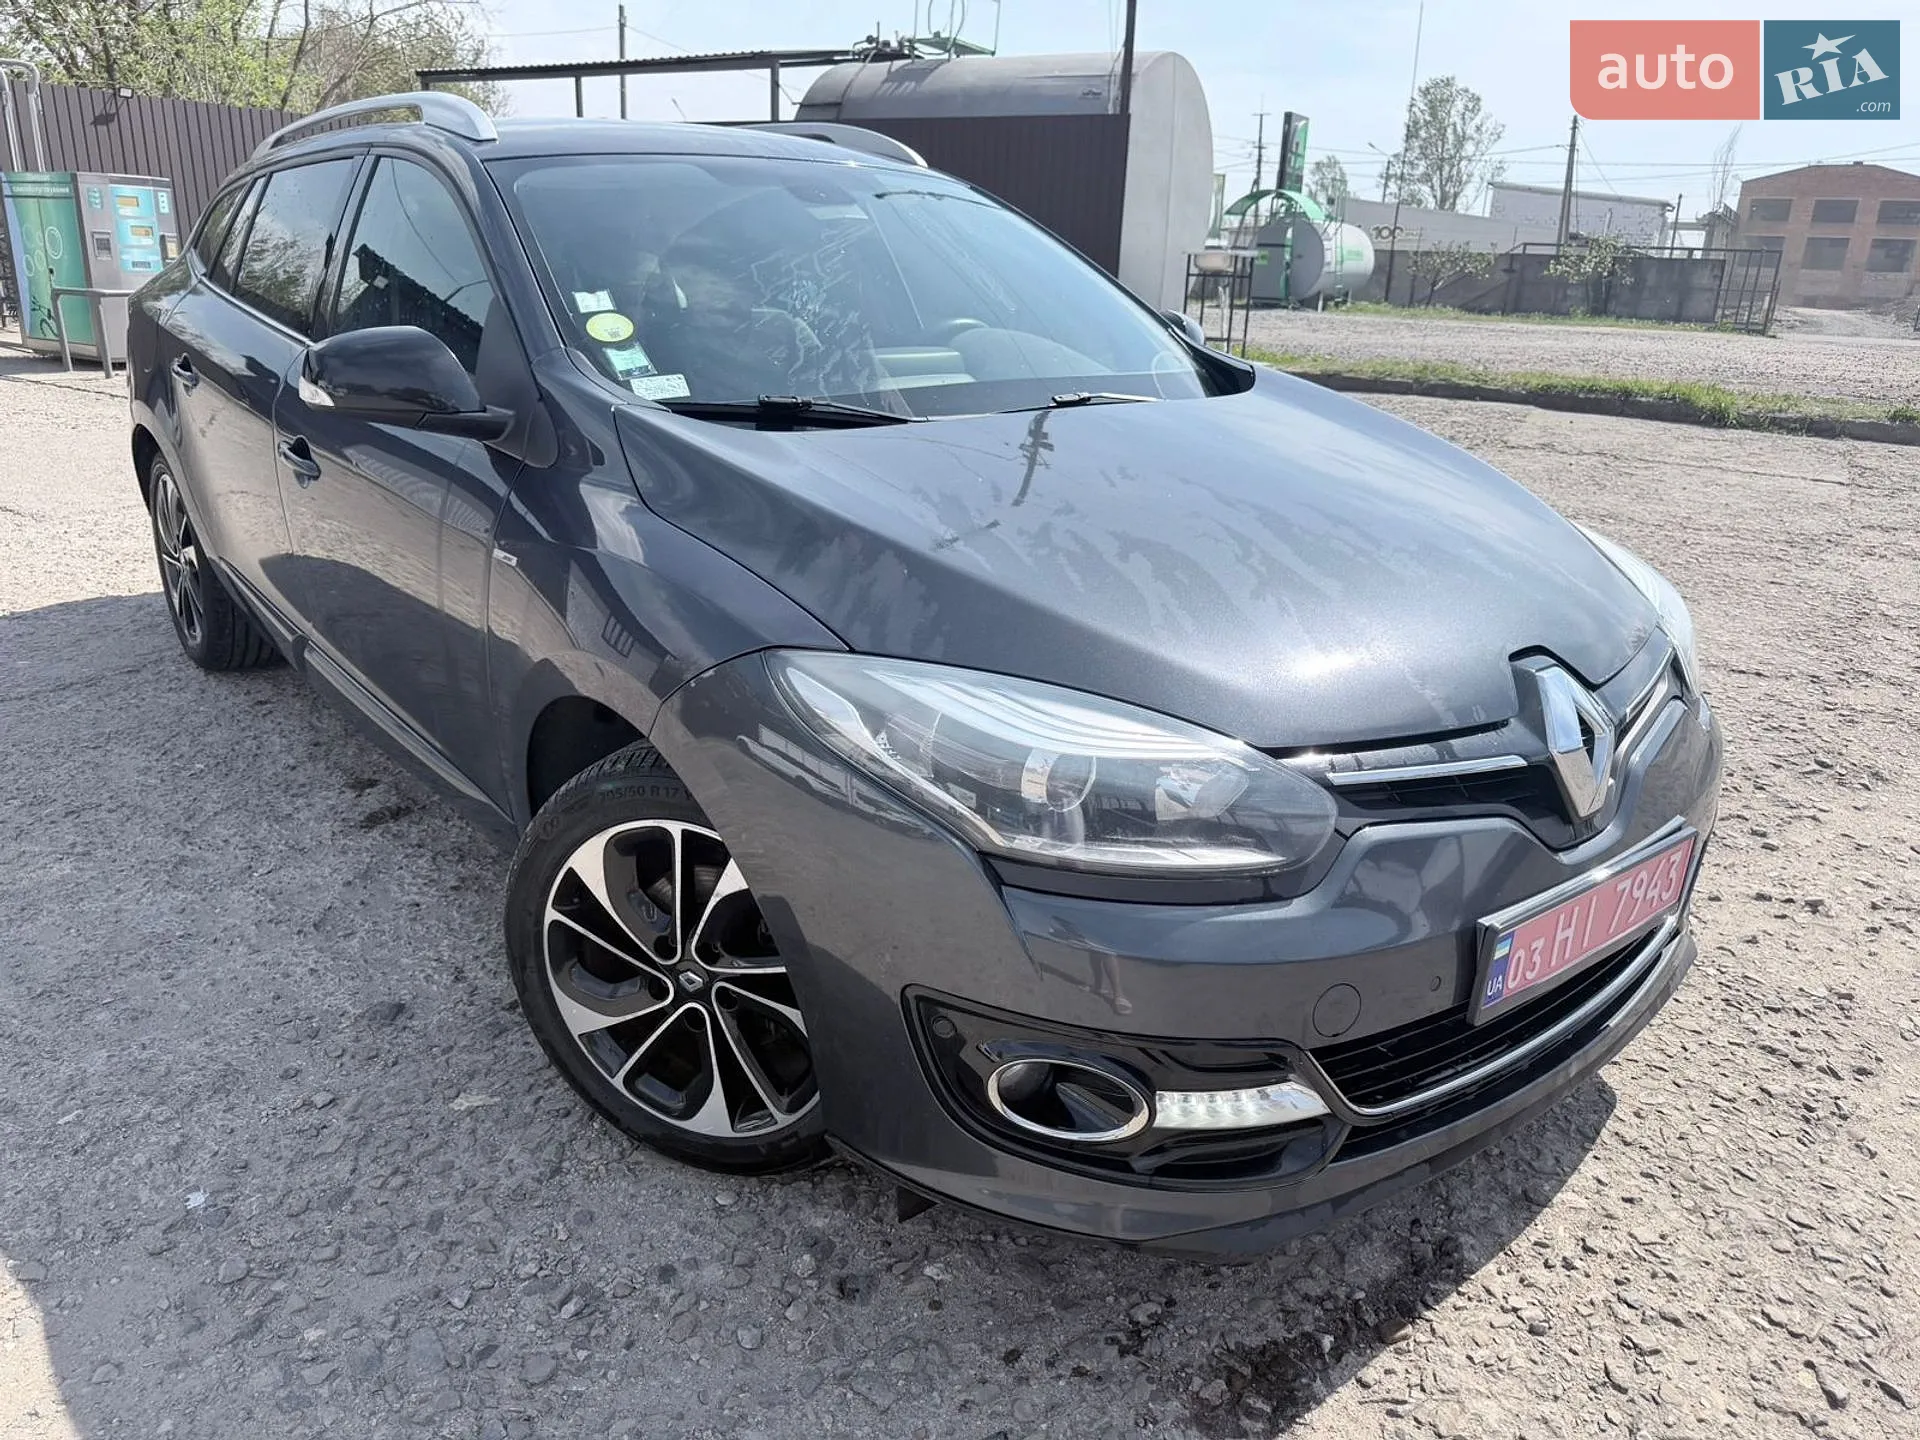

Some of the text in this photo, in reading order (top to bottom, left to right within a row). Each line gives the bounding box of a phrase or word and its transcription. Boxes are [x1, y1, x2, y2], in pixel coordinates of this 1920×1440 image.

[1507, 855, 1681, 989] 03 HI 7943
[1486, 975, 1504, 996] UA
